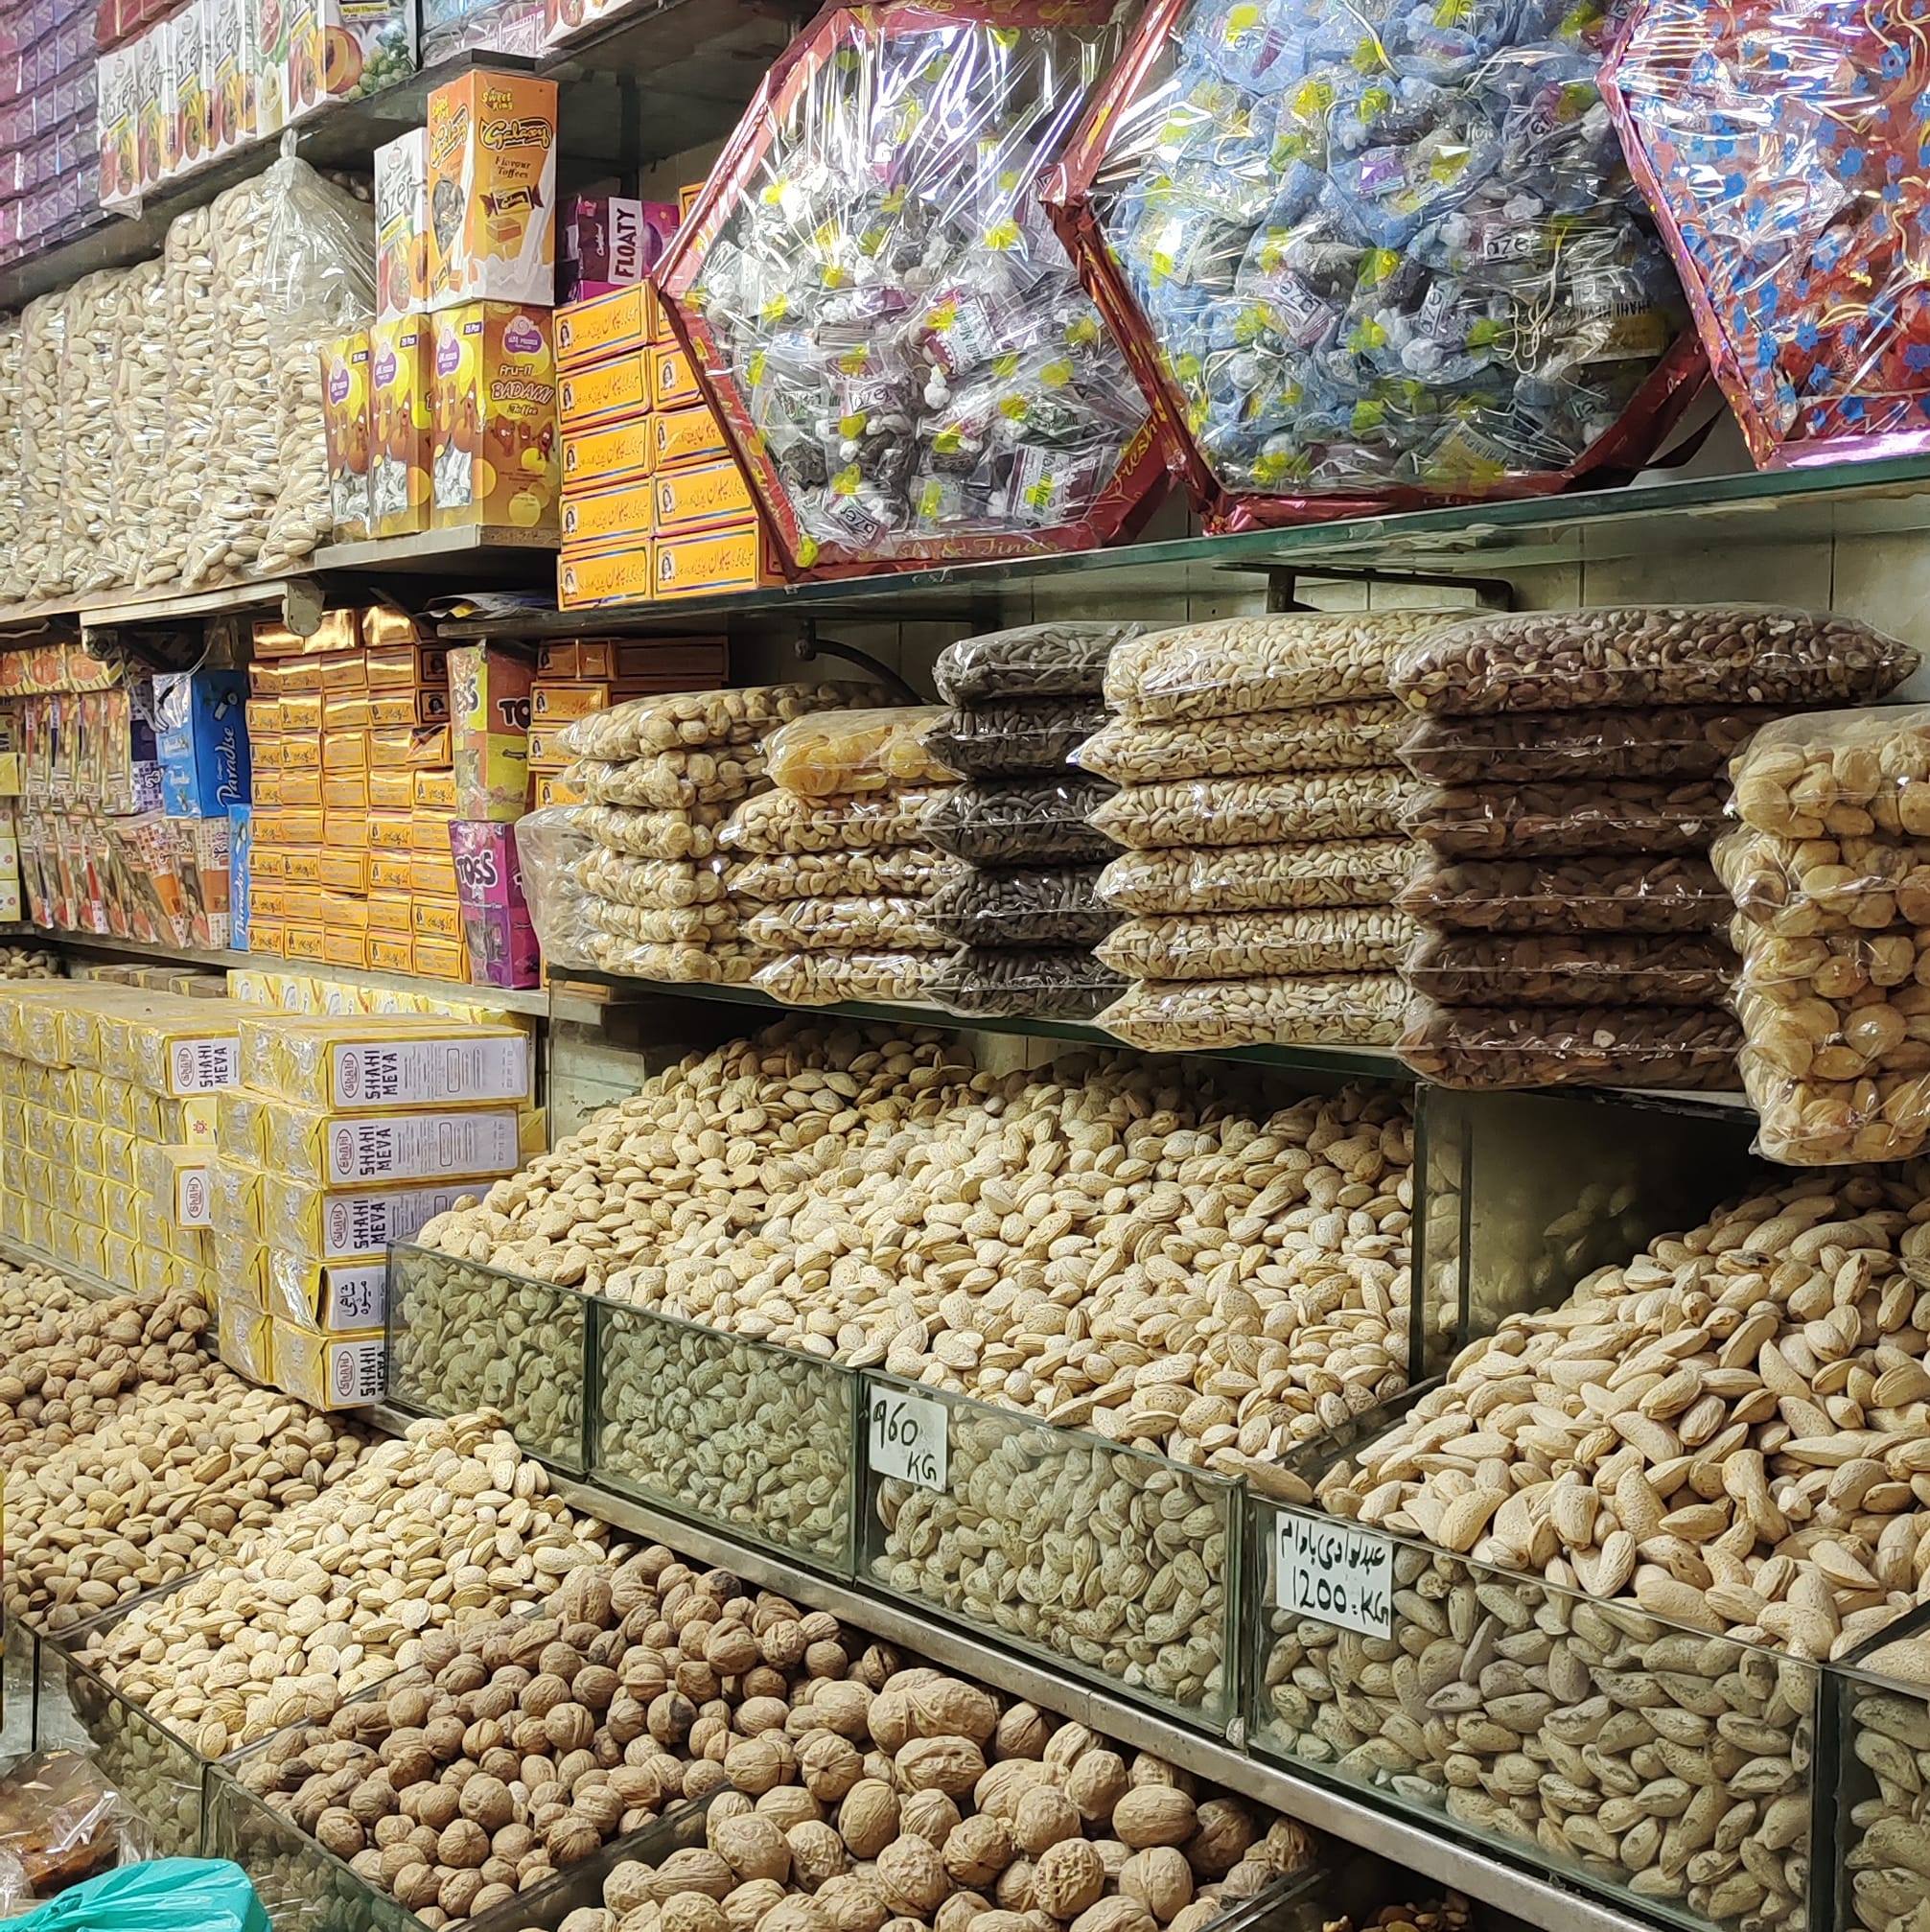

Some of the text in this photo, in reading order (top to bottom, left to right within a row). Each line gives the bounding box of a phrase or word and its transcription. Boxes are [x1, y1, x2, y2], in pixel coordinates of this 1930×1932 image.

[481, 90, 512, 103] Sweet
[482, 119, 551, 151] Galaxy
[495, 156, 531, 169] Flavour
[498, 167, 529, 178] Toffees
[615, 208, 638, 277] FLOATY
[491, 381, 555, 405] BADAMI
[218, 727, 242, 808] Paradise
[456, 850, 497, 886] TOSS
[198, 1046, 213, 1088] SHAHI
[214, 1047, 228, 1084] MEVA
[364, 1050, 381, 1100] SHAHI
[383, 1053, 398, 1095] MEVA
[359, 1126, 375, 1175] SHAHI
[377, 1128, 392, 1171] MEVA
[353, 1199, 369, 1249] SHAHI
[371, 1201, 385, 1245] MEVA
[360, 1346, 377, 1397] SHAHI
[872, 1400, 918, 1450] 960
[907, 1451, 937, 1482] KG
